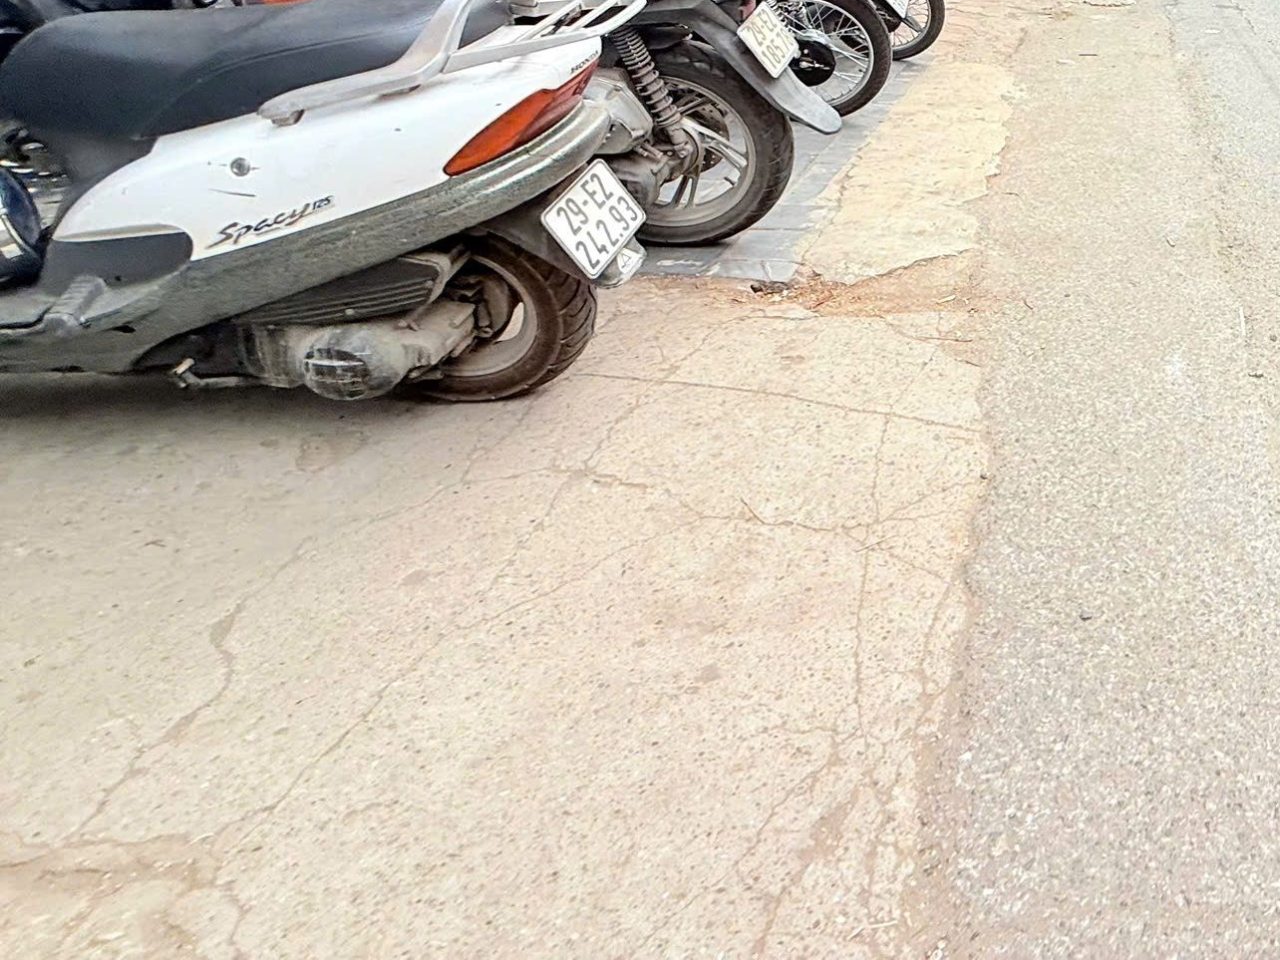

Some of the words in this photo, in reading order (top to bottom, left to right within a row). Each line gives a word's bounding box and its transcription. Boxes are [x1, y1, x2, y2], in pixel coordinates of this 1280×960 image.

[205, 202, 311, 251] Spacy
[556, 172, 614, 236] 29-E2
[575, 195, 638, 270] 242.93
